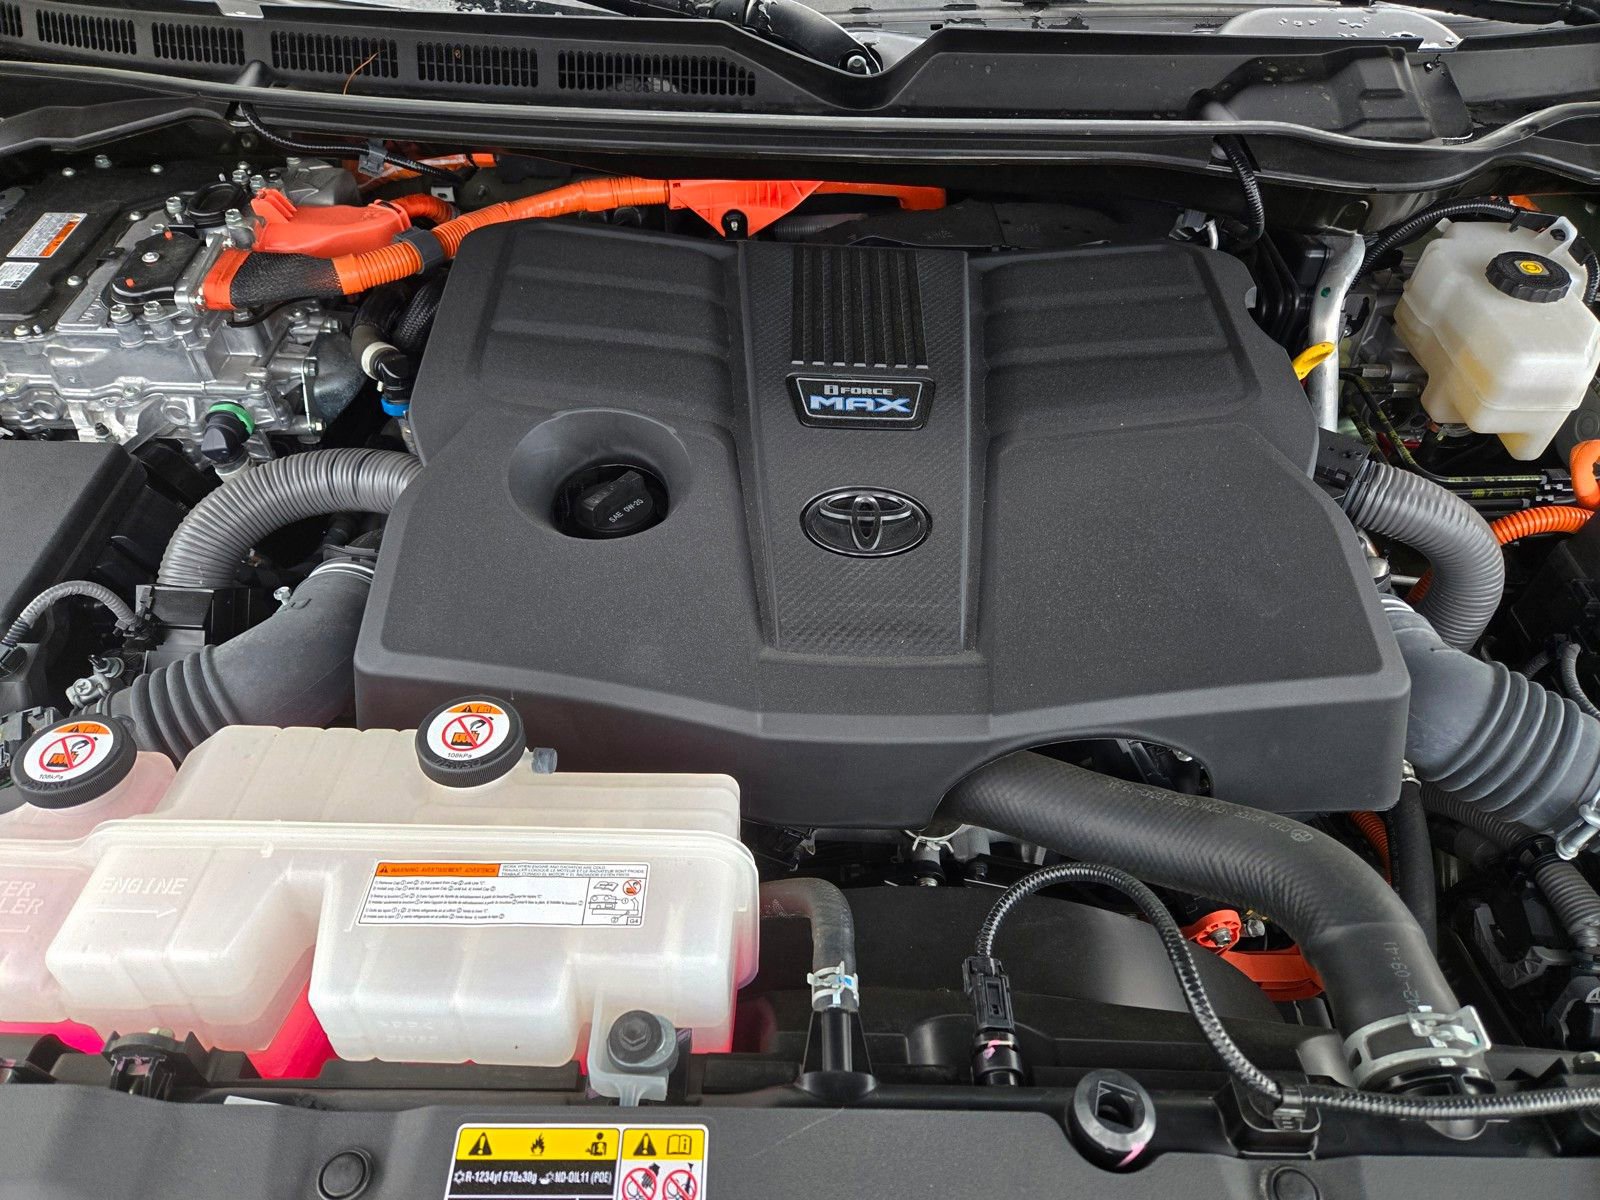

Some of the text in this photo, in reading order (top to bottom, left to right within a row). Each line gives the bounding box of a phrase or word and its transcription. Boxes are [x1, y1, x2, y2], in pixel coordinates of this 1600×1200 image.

[840, 387, 893, 396] FORCE
[809, 395, 912, 413] MAX
[608, 498, 644, 523] SAE 0W-20
[101, 877, 188, 895] ENGINE
[465, 1170, 502, 1185] R-1234yf
[502, 1171, 538, 1185] 670±30g
[590, 1171, 612, 1185] (POE)
